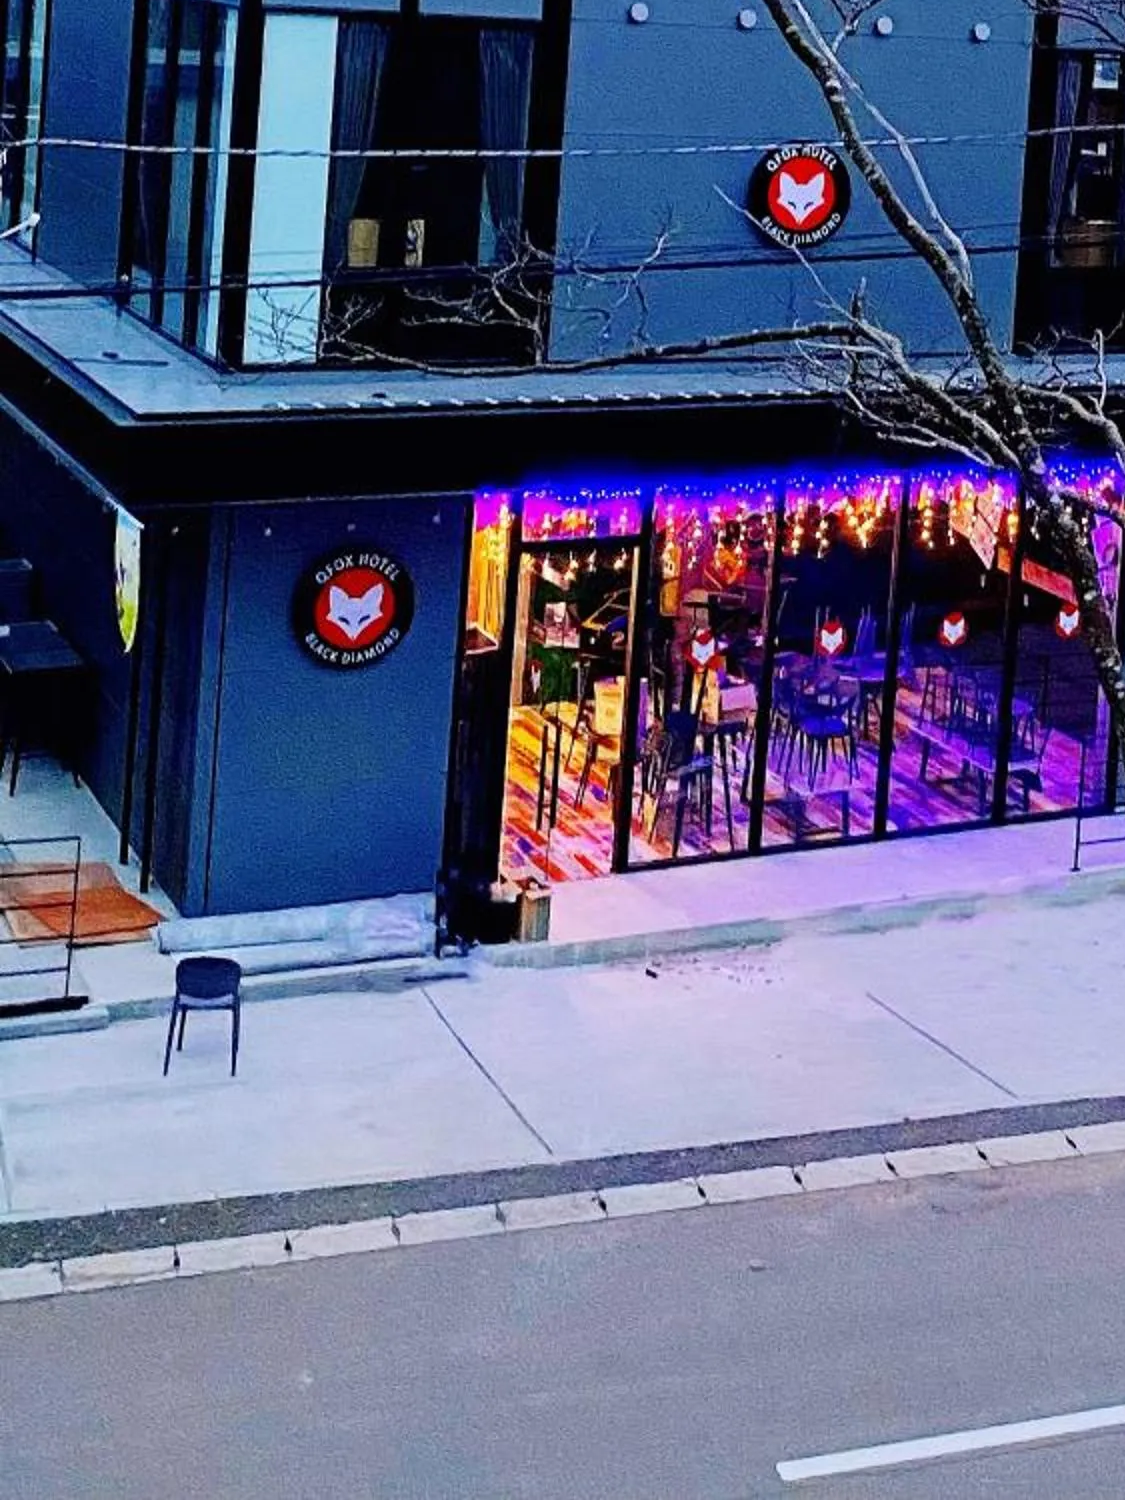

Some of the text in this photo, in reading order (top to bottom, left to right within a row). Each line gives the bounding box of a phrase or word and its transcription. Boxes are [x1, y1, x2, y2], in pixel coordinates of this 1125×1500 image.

[761, 212, 841, 245] BLACK DIAMOND
[359, 553, 400, 581] HOTEL
[305, 627, 400, 665] BLACK DIAMOND
